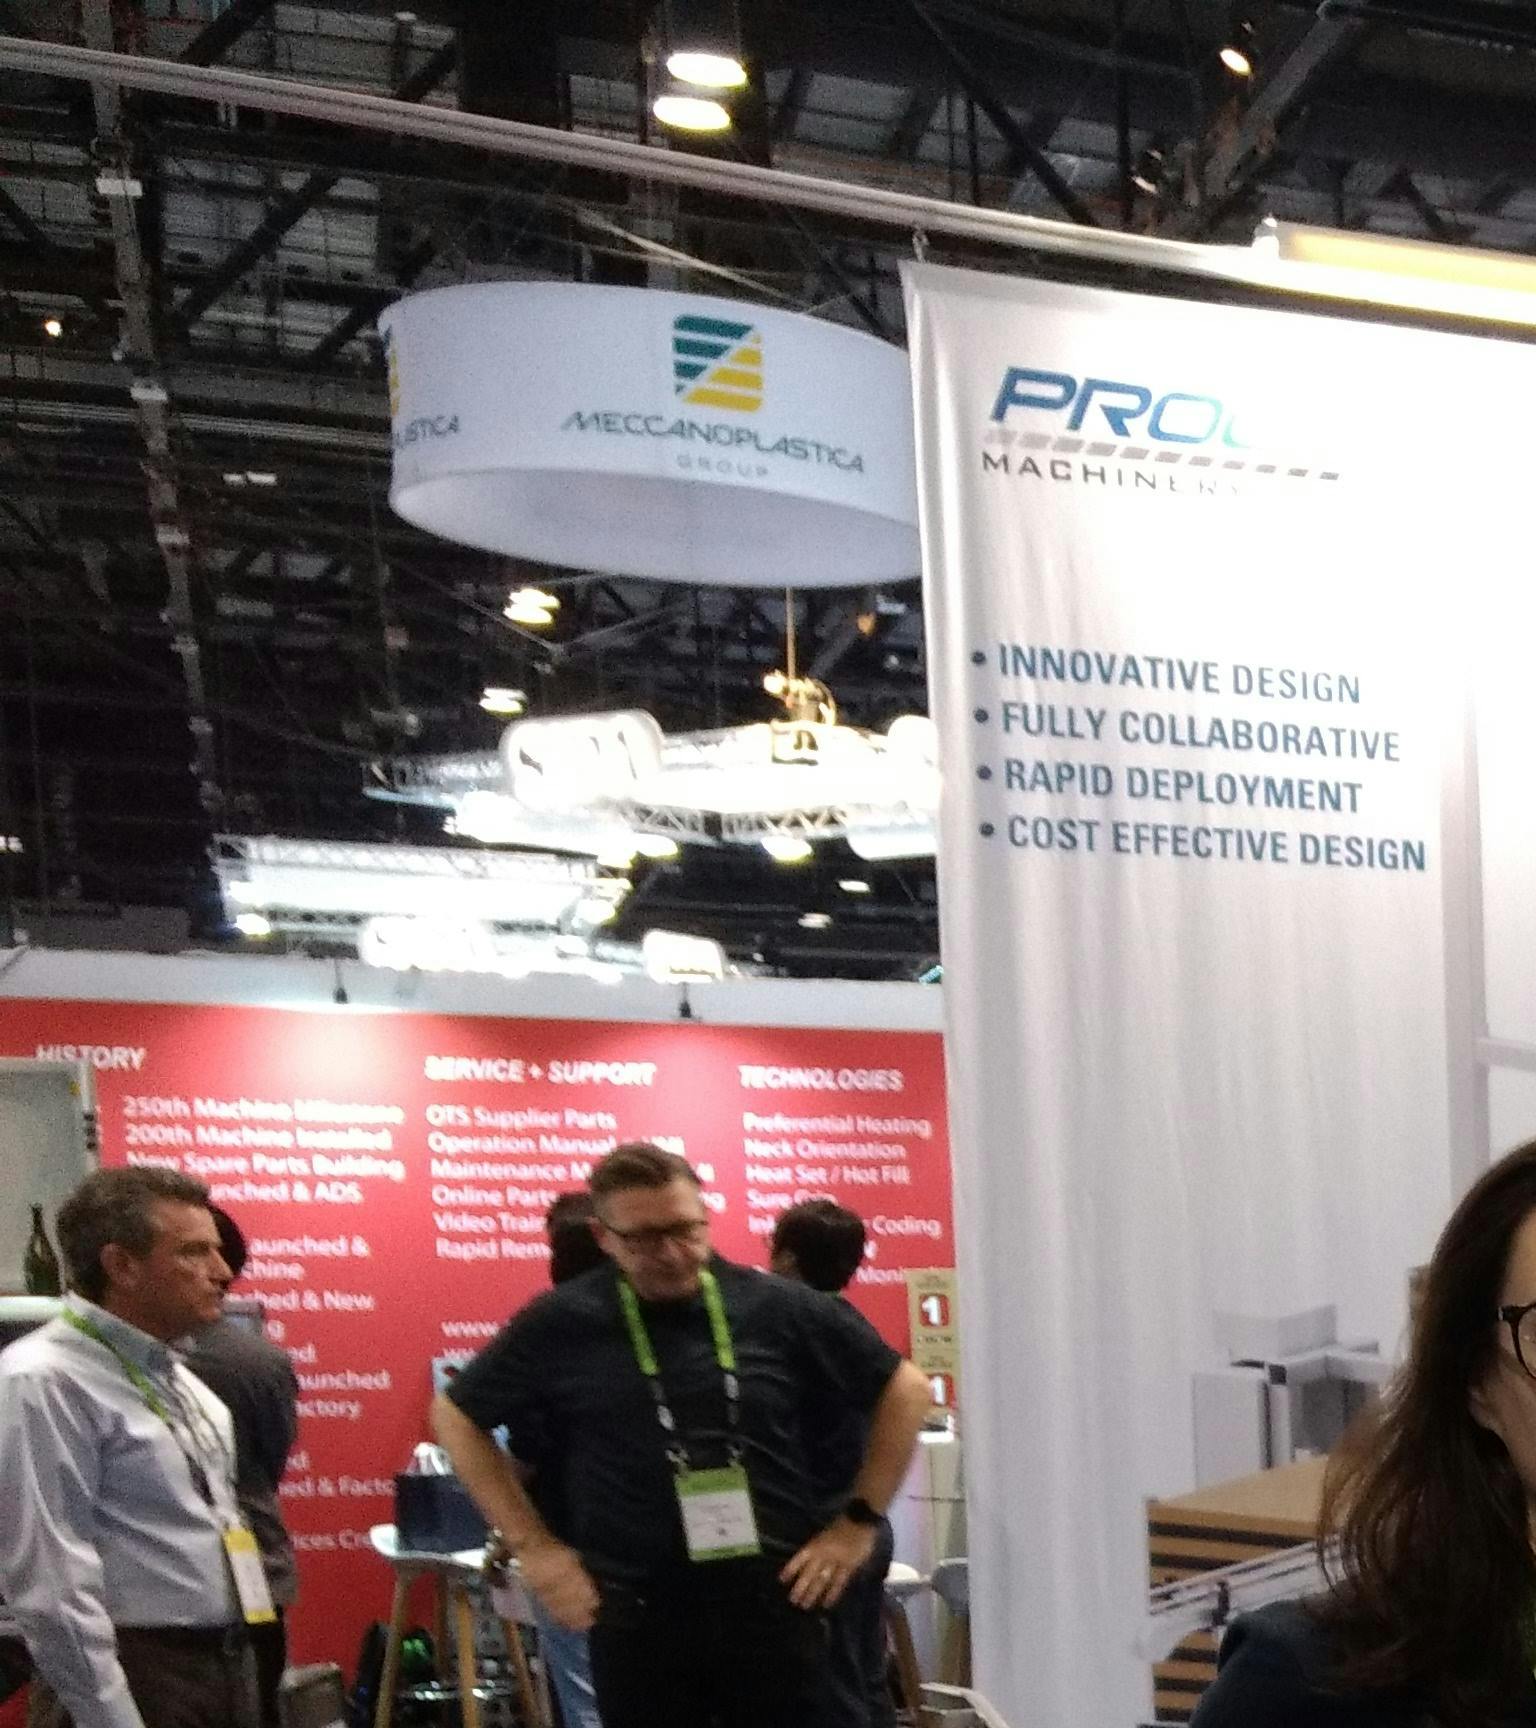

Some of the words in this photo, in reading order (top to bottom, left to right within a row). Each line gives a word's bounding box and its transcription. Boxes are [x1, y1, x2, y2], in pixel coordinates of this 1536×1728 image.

[561, 410, 865, 475] MECCANOPLASTICA
[999, 643, 1220, 694] INNOVATIVE
[1231, 664, 1361, 705] DESIGN
[1001, 704, 1107, 740] FULLY
[1119, 711, 1400, 763] COLLABORATIVE
[1005, 760, 1112, 796] RAPID
[1126, 767, 1364, 813] DEPLOYMENT
[1007, 816, 1101, 852] COST
[1111, 821, 1289, 864] EFFECTIVE
[1300, 836, 1427, 873] DESIGN
[424, 1055, 525, 1083] SERVICE
[549, 1061, 656, 1086] SUPPORT
[738, 1064, 904, 1092] TECHNOLOGIES
[193, 1097, 293, 1121] Machine
[425, 1104, 471, 1127] OTS
[473, 1107, 560, 1131] Supplier
[565, 1109, 617, 1130] Parts
[196, 1125, 293, 1148] Machine
[743, 1112, 854, 1134] Preferential
[856, 1116, 932, 1141] Heating
[427, 1131, 537, 1156] Operation
[796, 1138, 907, 1160] Orientation
[252, 1153, 310, 1176] Parts
[312, 1154, 405, 1182] Building
[430, 1158, 567, 1181] Maintenance
[432, 1184, 501, 1207] Online
[432, 1212, 497, 1233] Video
[872, 1215, 942, 1240] Coding
[435, 1237, 498, 1261] Rapid
